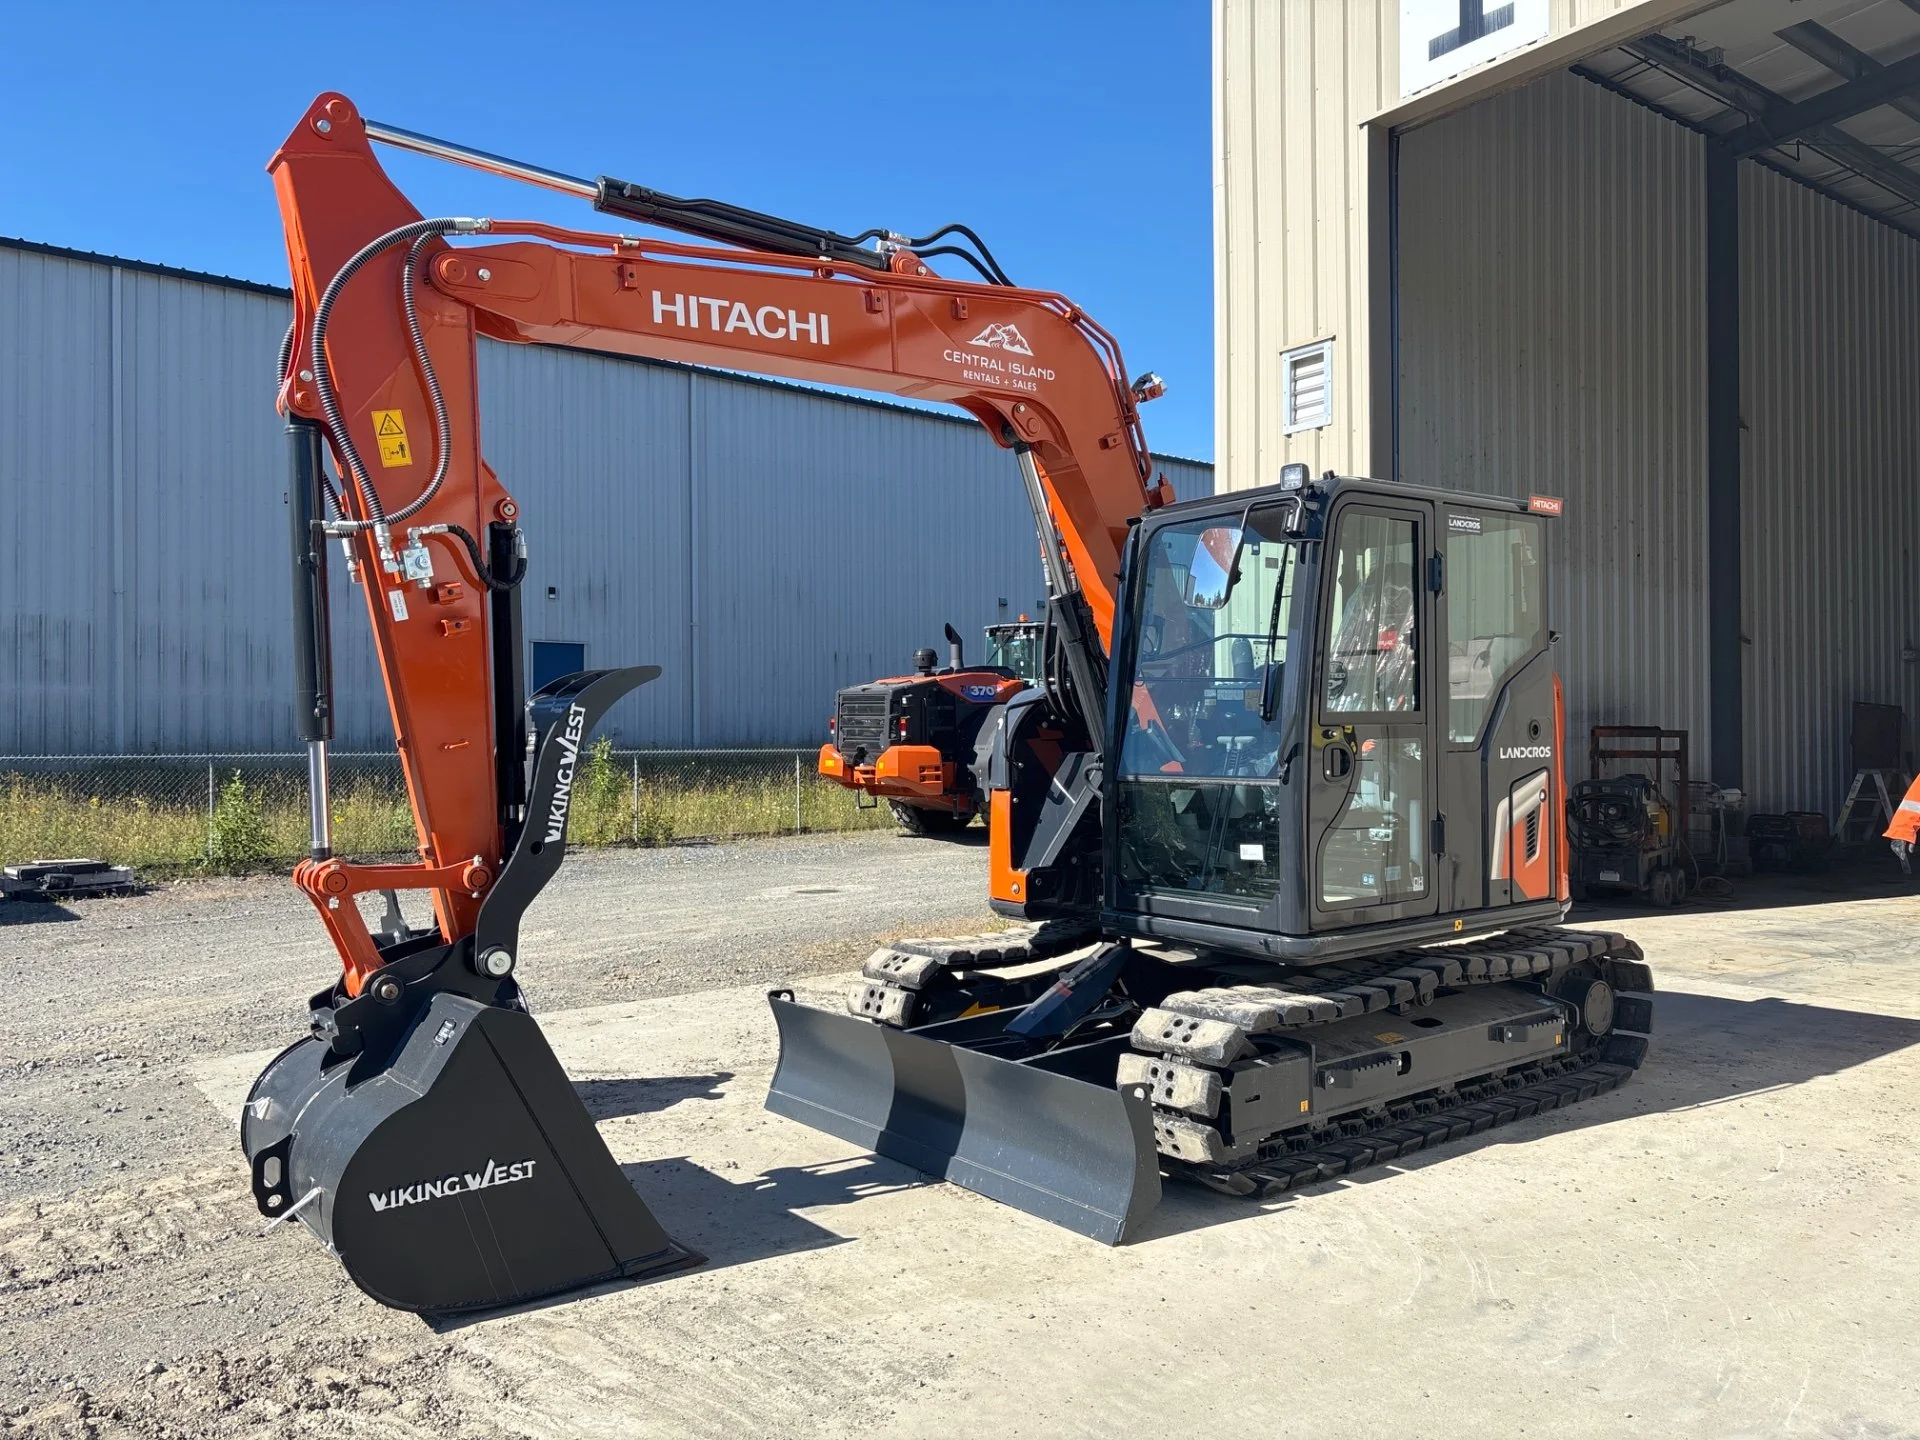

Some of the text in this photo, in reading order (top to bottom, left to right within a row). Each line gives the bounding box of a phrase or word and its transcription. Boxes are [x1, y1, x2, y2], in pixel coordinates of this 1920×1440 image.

[652, 290, 830, 345] HITACHI
[943, 349, 1056, 381] CENTRAL ISLAND
[963, 369, 1001, 385] RENTALS
[1012, 379, 1037, 392] SALES
[1533, 499, 1559, 511] HITACHI
[1448, 518, 1481, 530] LANDCROS
[970, 685, 996, 696] 370
[1500, 746, 1551, 759] LANDCROS
[544, 702, 586, 844] VIKING WEST
[368, 1158, 537, 1213] VIKING WEST
